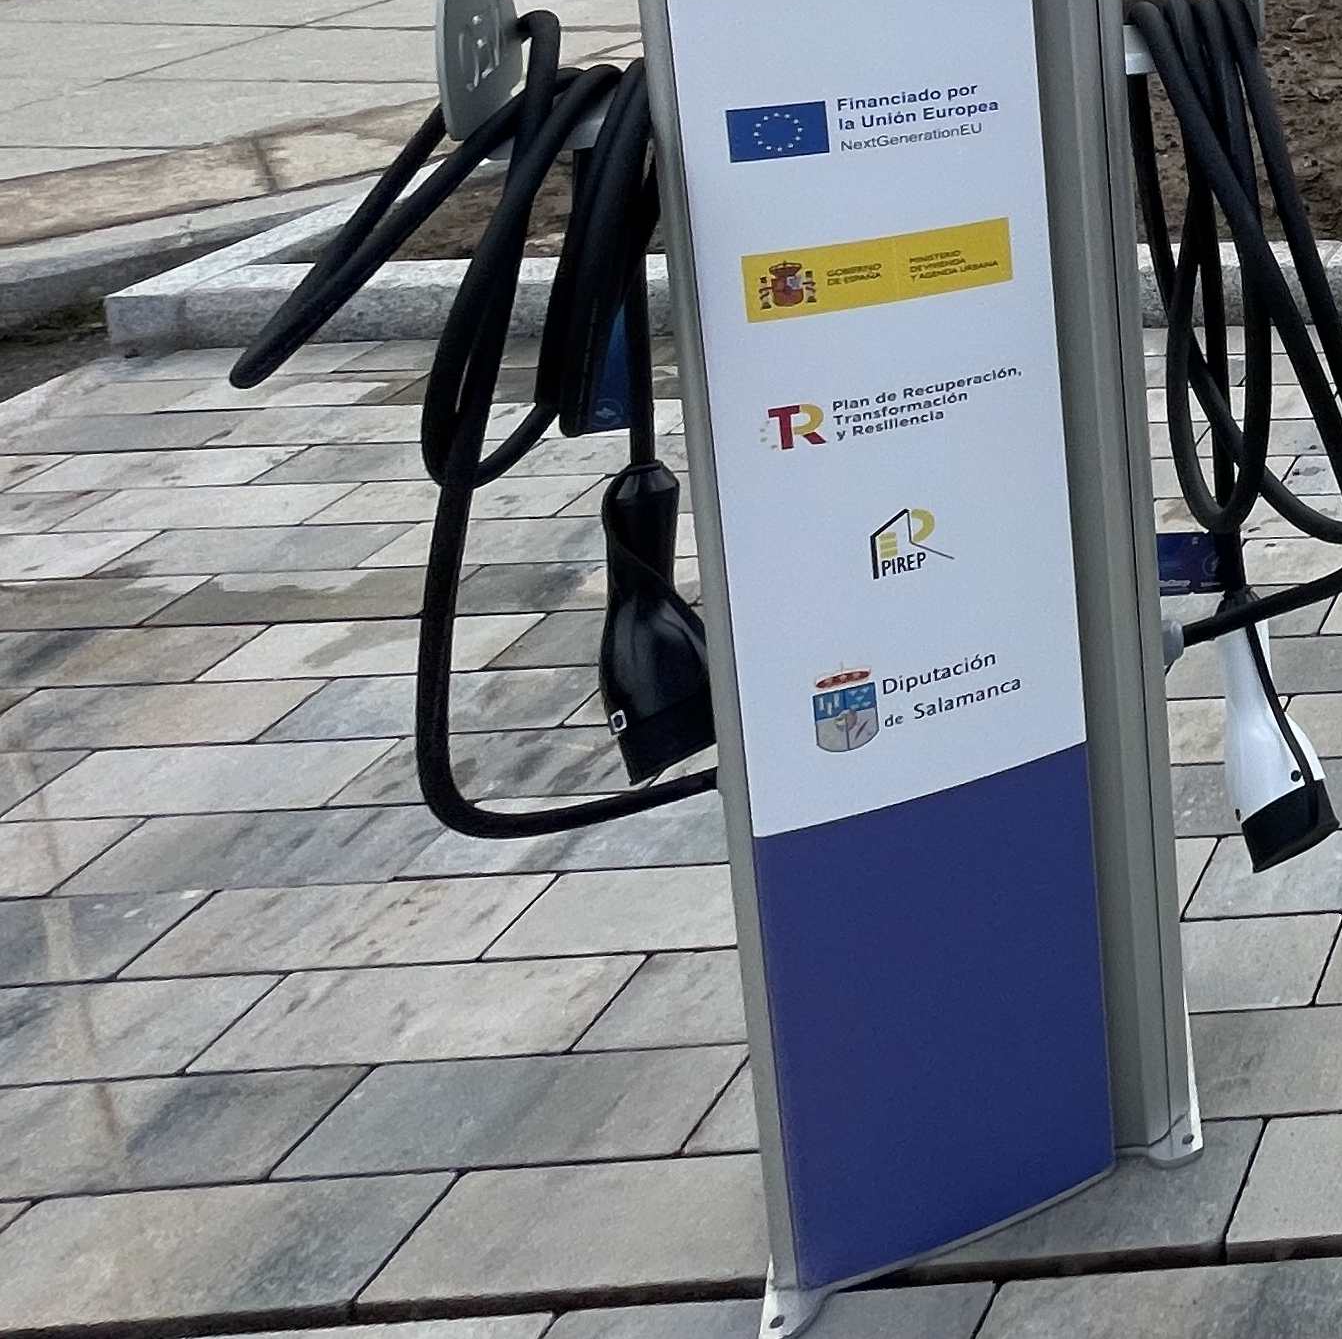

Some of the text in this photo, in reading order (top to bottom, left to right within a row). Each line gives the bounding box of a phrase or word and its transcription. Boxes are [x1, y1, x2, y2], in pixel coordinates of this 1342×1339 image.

[837, 83, 978, 111] Financiado por
[839, 99, 1000, 131] la Unión Europea
[841, 122, 983, 151] NextGenerationEU
[832, 367, 1022, 412] Plan de Recuperación,
[833, 392, 968, 426] Transformación
[837, 410, 945, 441] y Resiliencia
[881, 552, 926, 577] PIREP
[882, 652, 997, 695] Diputación
[884, 678, 1022, 728] de Salamanca
